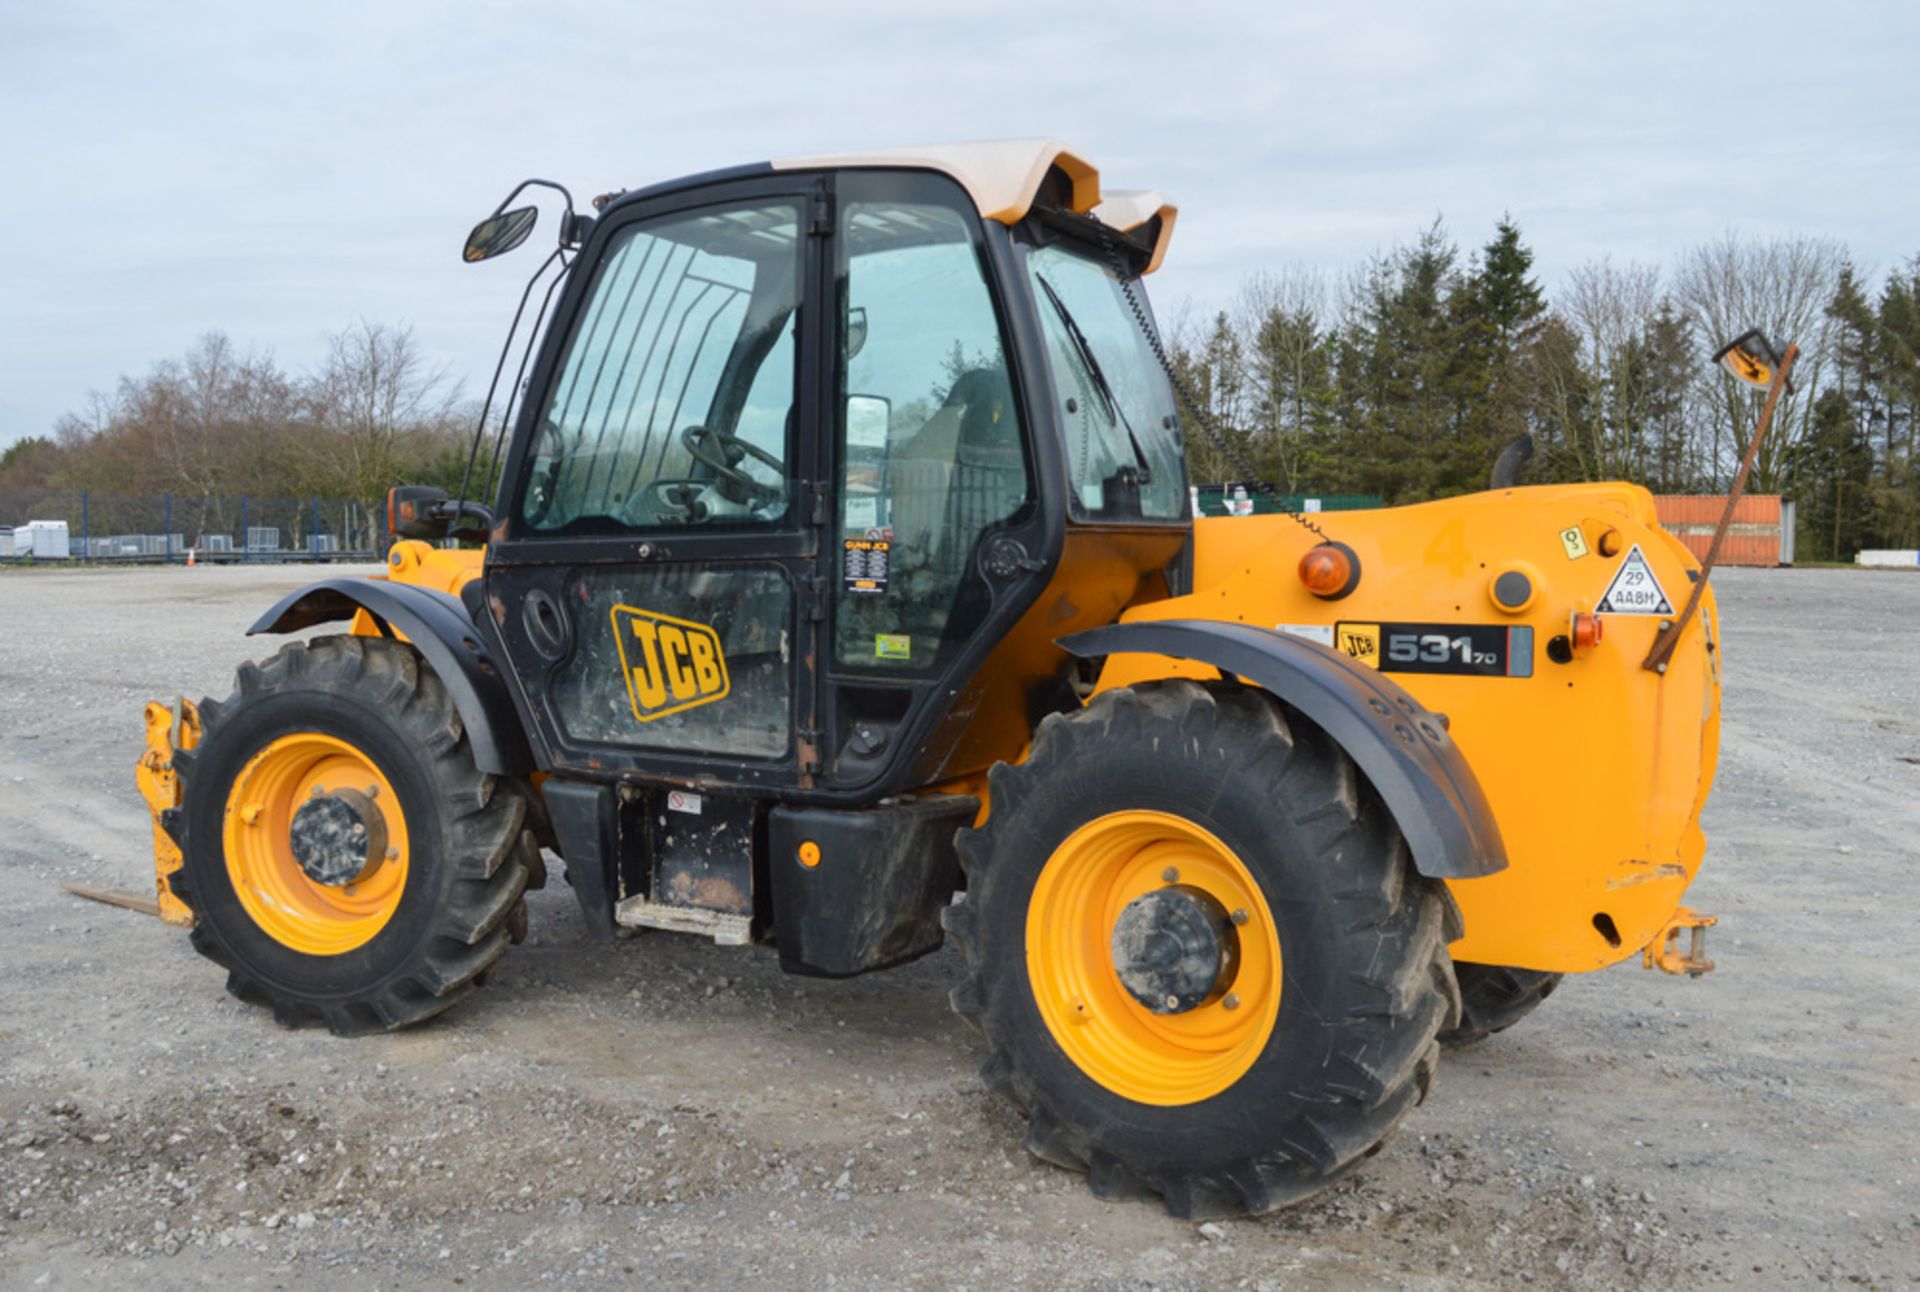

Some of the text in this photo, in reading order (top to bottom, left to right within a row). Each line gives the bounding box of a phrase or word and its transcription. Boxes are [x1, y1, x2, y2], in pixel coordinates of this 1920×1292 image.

[1625, 571, 1645, 586] 29
[1346, 634, 1375, 657] JCB
[1388, 634, 1472, 663] 531
[631, 618, 721, 709] JCB
